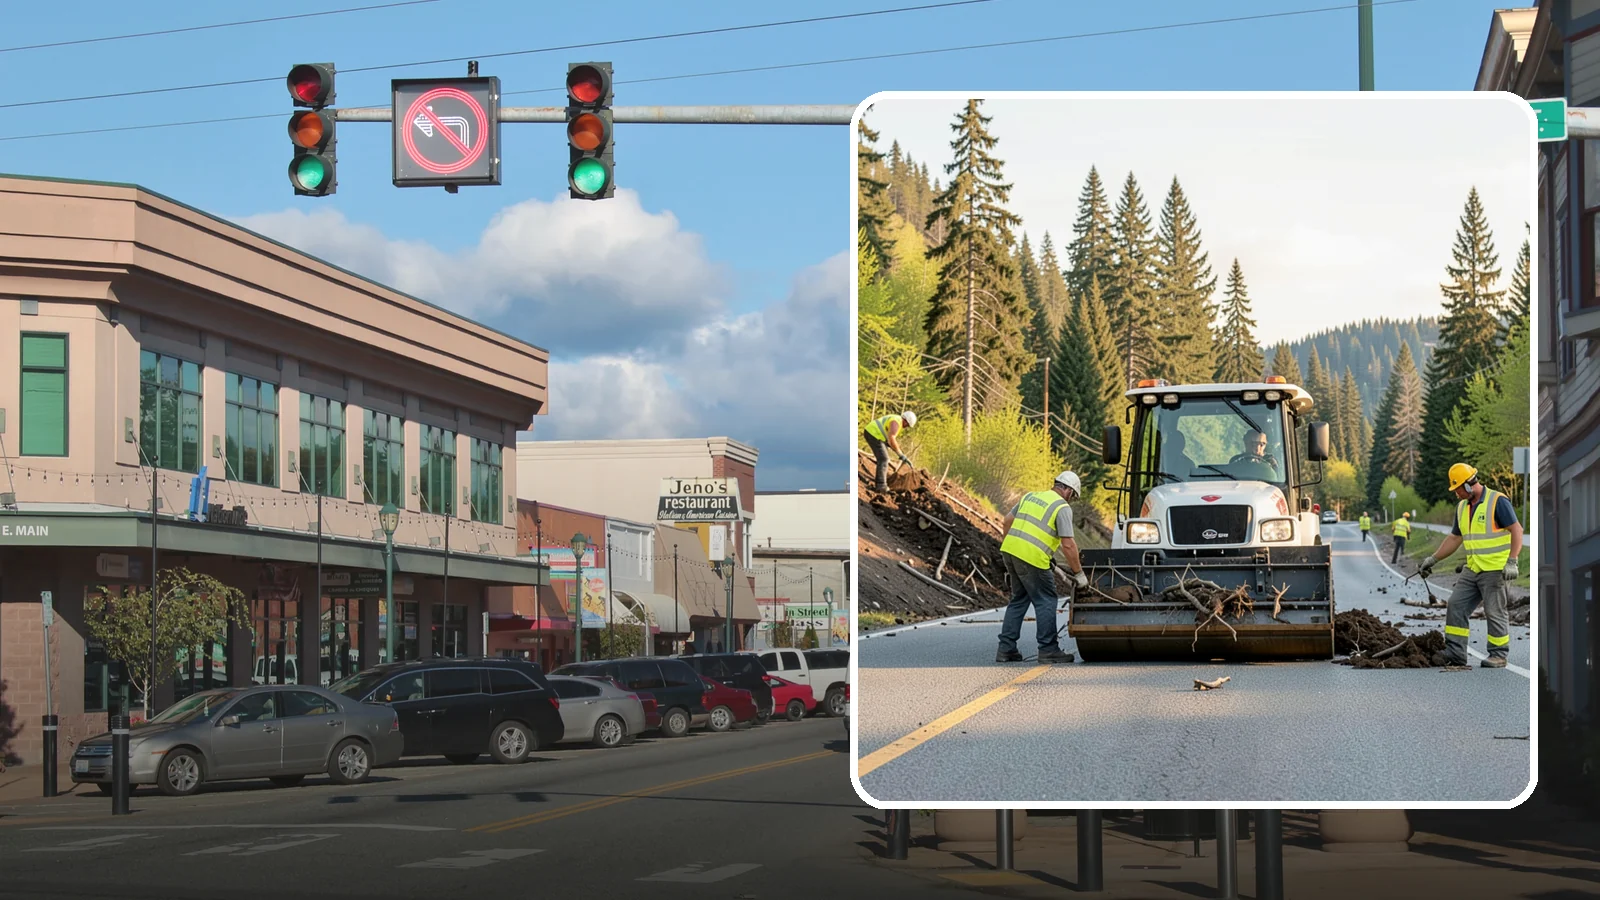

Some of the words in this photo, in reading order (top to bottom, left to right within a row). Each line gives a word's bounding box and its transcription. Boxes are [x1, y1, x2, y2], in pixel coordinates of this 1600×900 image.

[669, 479, 728, 495] Jeno's
[664, 495, 731, 509] restaurant
[658, 509, 682, 520] Italian
[686, 509, 714, 519] American
[715, 509, 738, 519] Cuisine
[2, 525, 13, 536] E.
[15, 525, 49, 536] MAIN
[797, 607, 828, 617] Street
